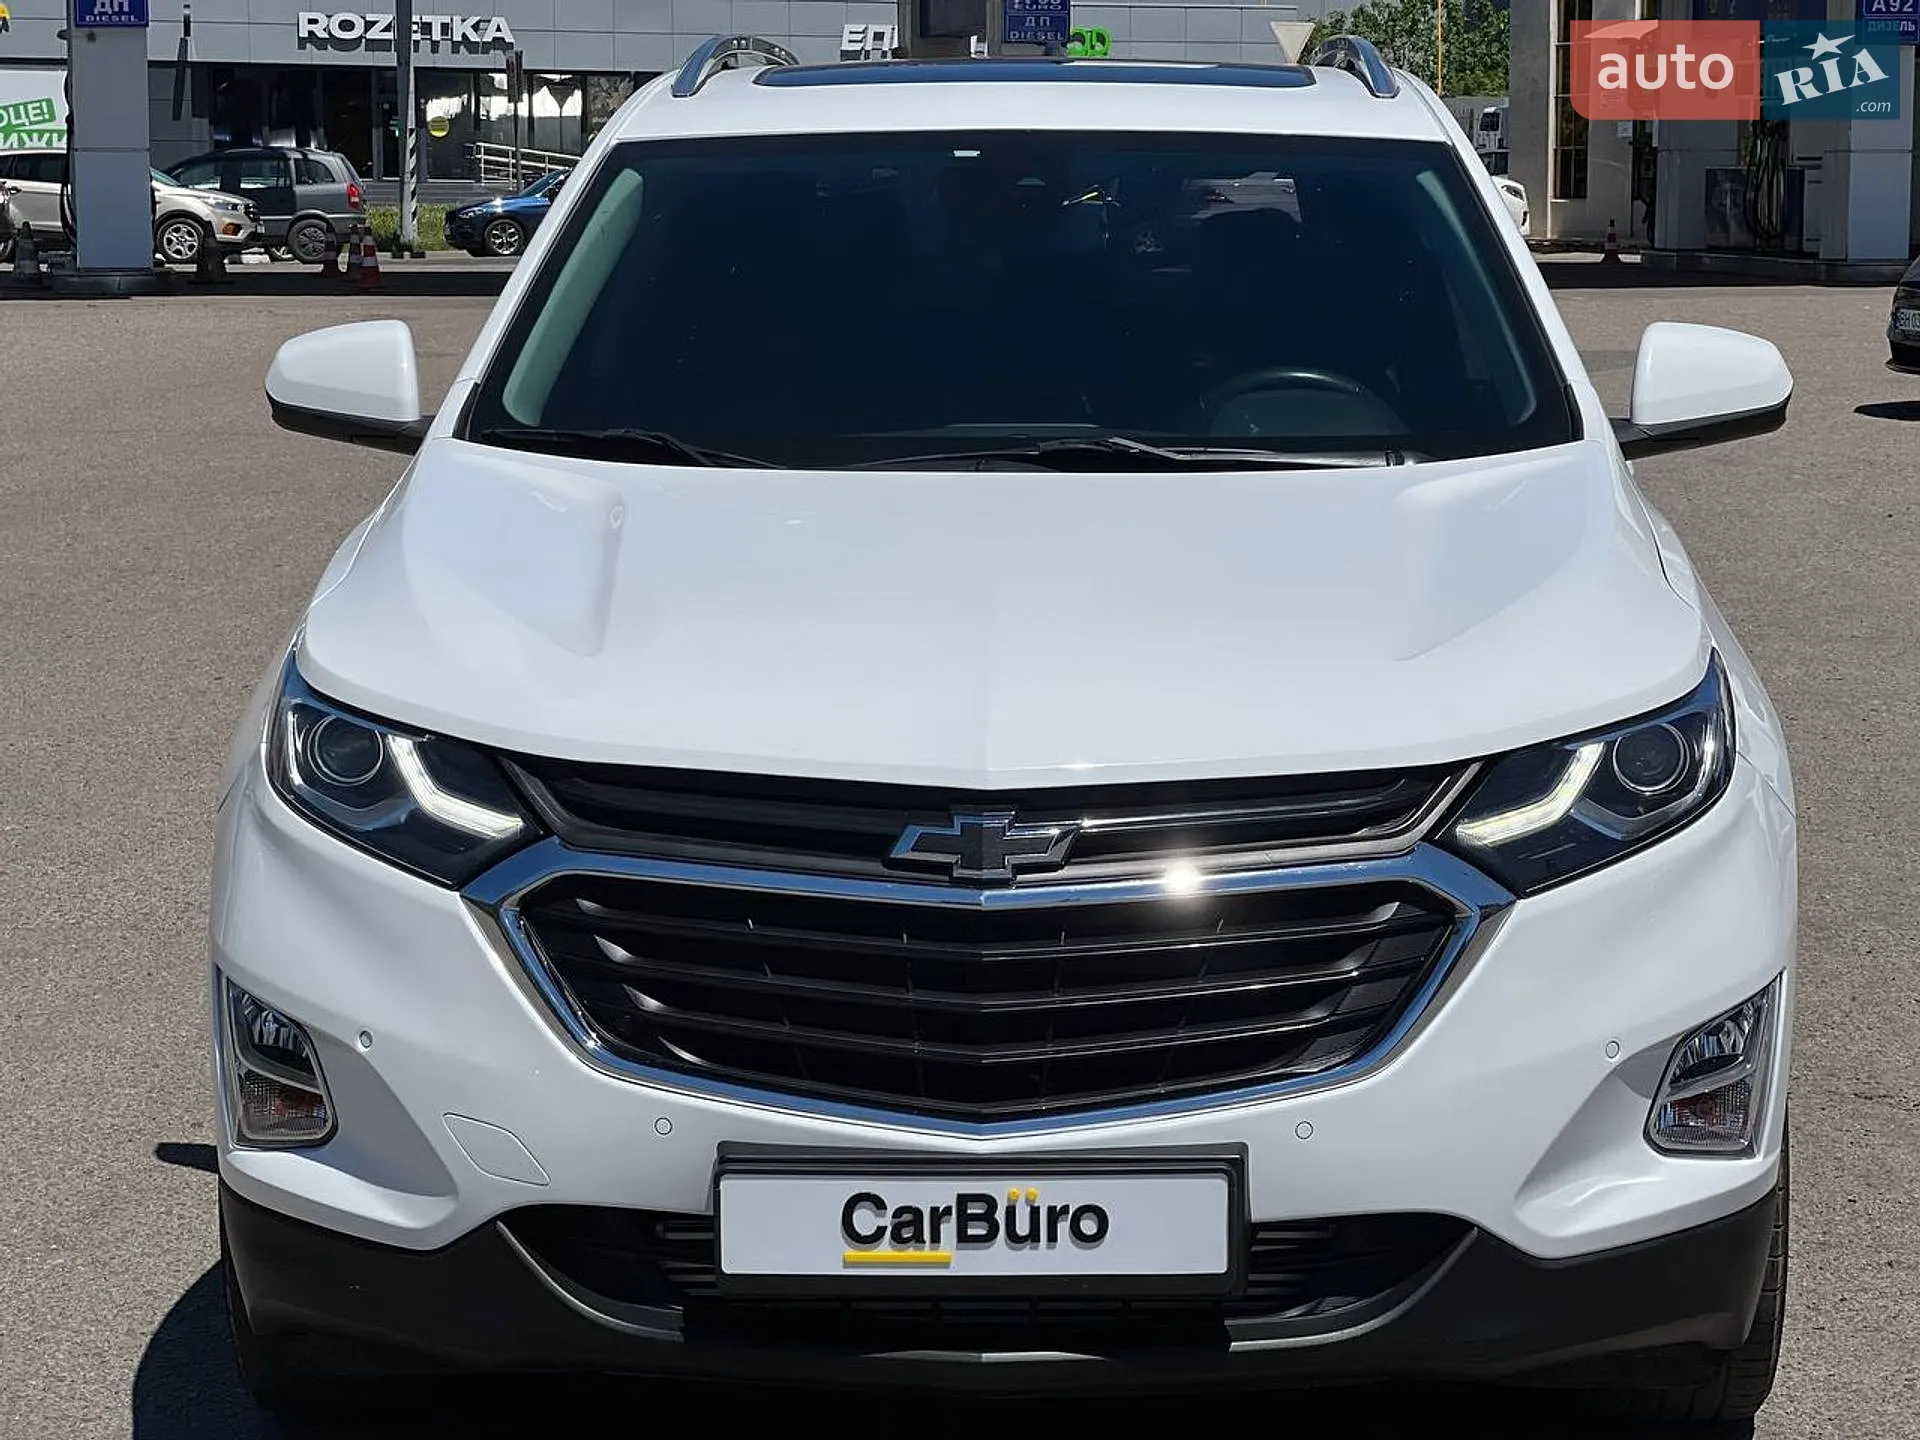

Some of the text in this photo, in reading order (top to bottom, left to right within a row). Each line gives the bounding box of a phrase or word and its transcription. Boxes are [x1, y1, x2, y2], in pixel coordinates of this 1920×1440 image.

[1024, 16, 1050, 27] ДП
[1867, 21, 1916, 32] ДИЗЕЛЬ
[1009, 31, 1064, 40] DIESEL
[841, 1187, 1110, 1245] CarBüro
